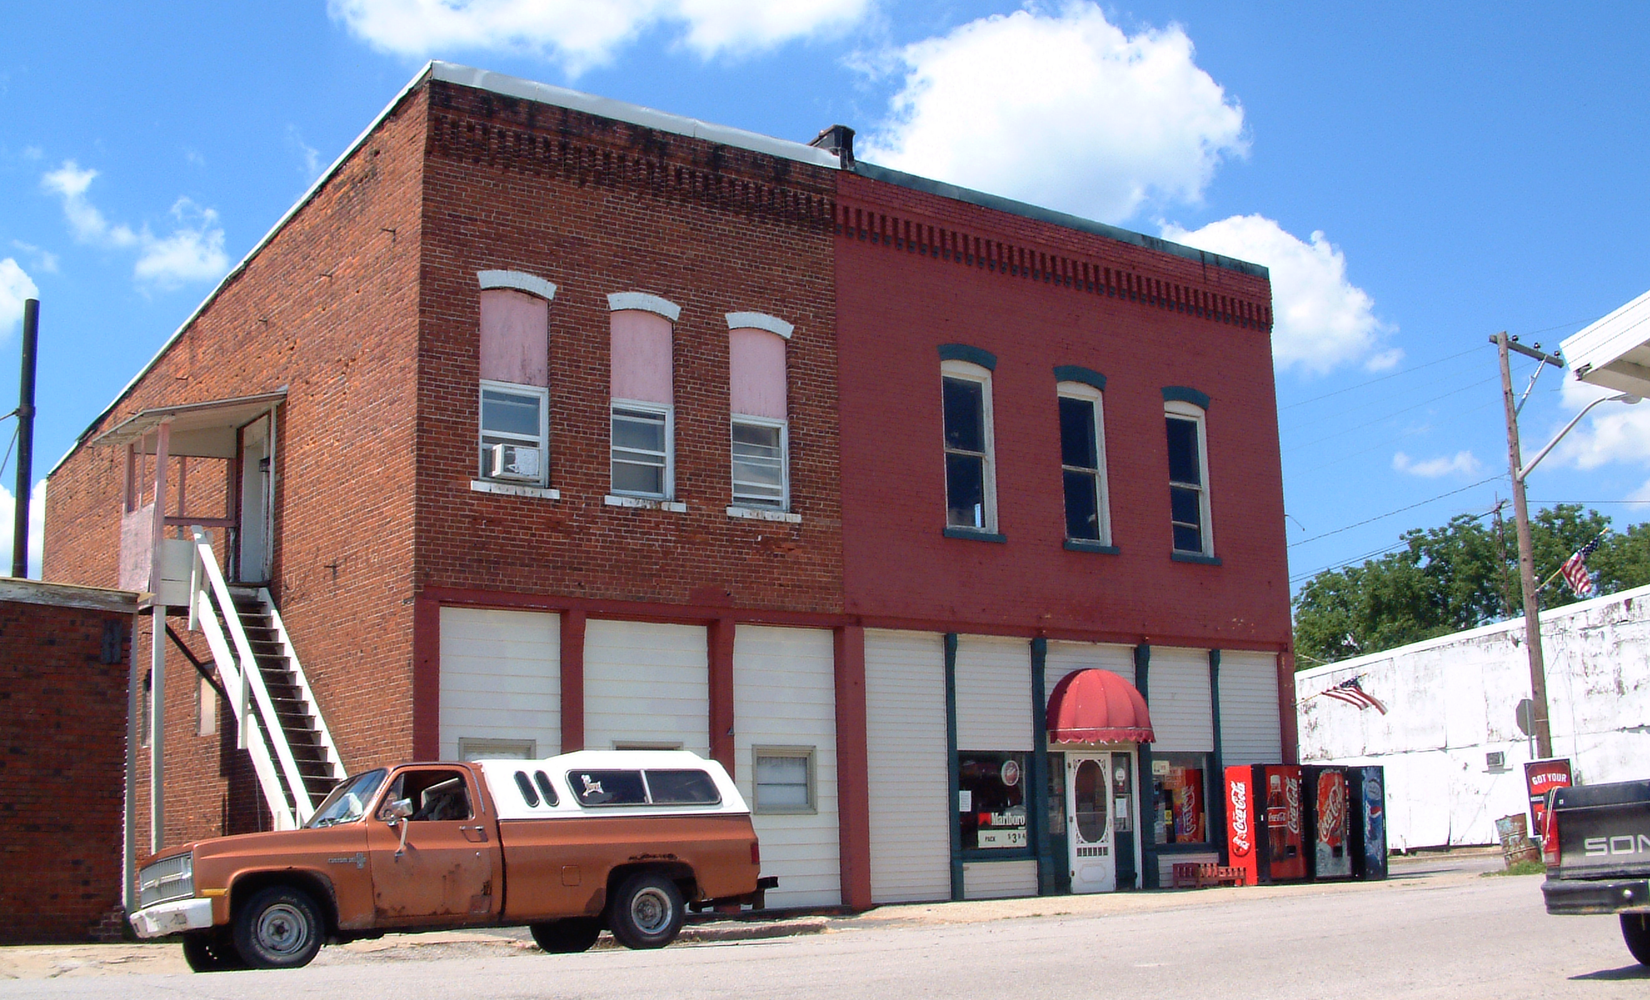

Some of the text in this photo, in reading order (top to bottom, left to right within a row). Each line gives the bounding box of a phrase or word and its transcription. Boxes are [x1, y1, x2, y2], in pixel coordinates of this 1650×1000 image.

[1532, 773, 1567, 785] GOT YOUR
[991, 811, 1026, 826] Marlboro
